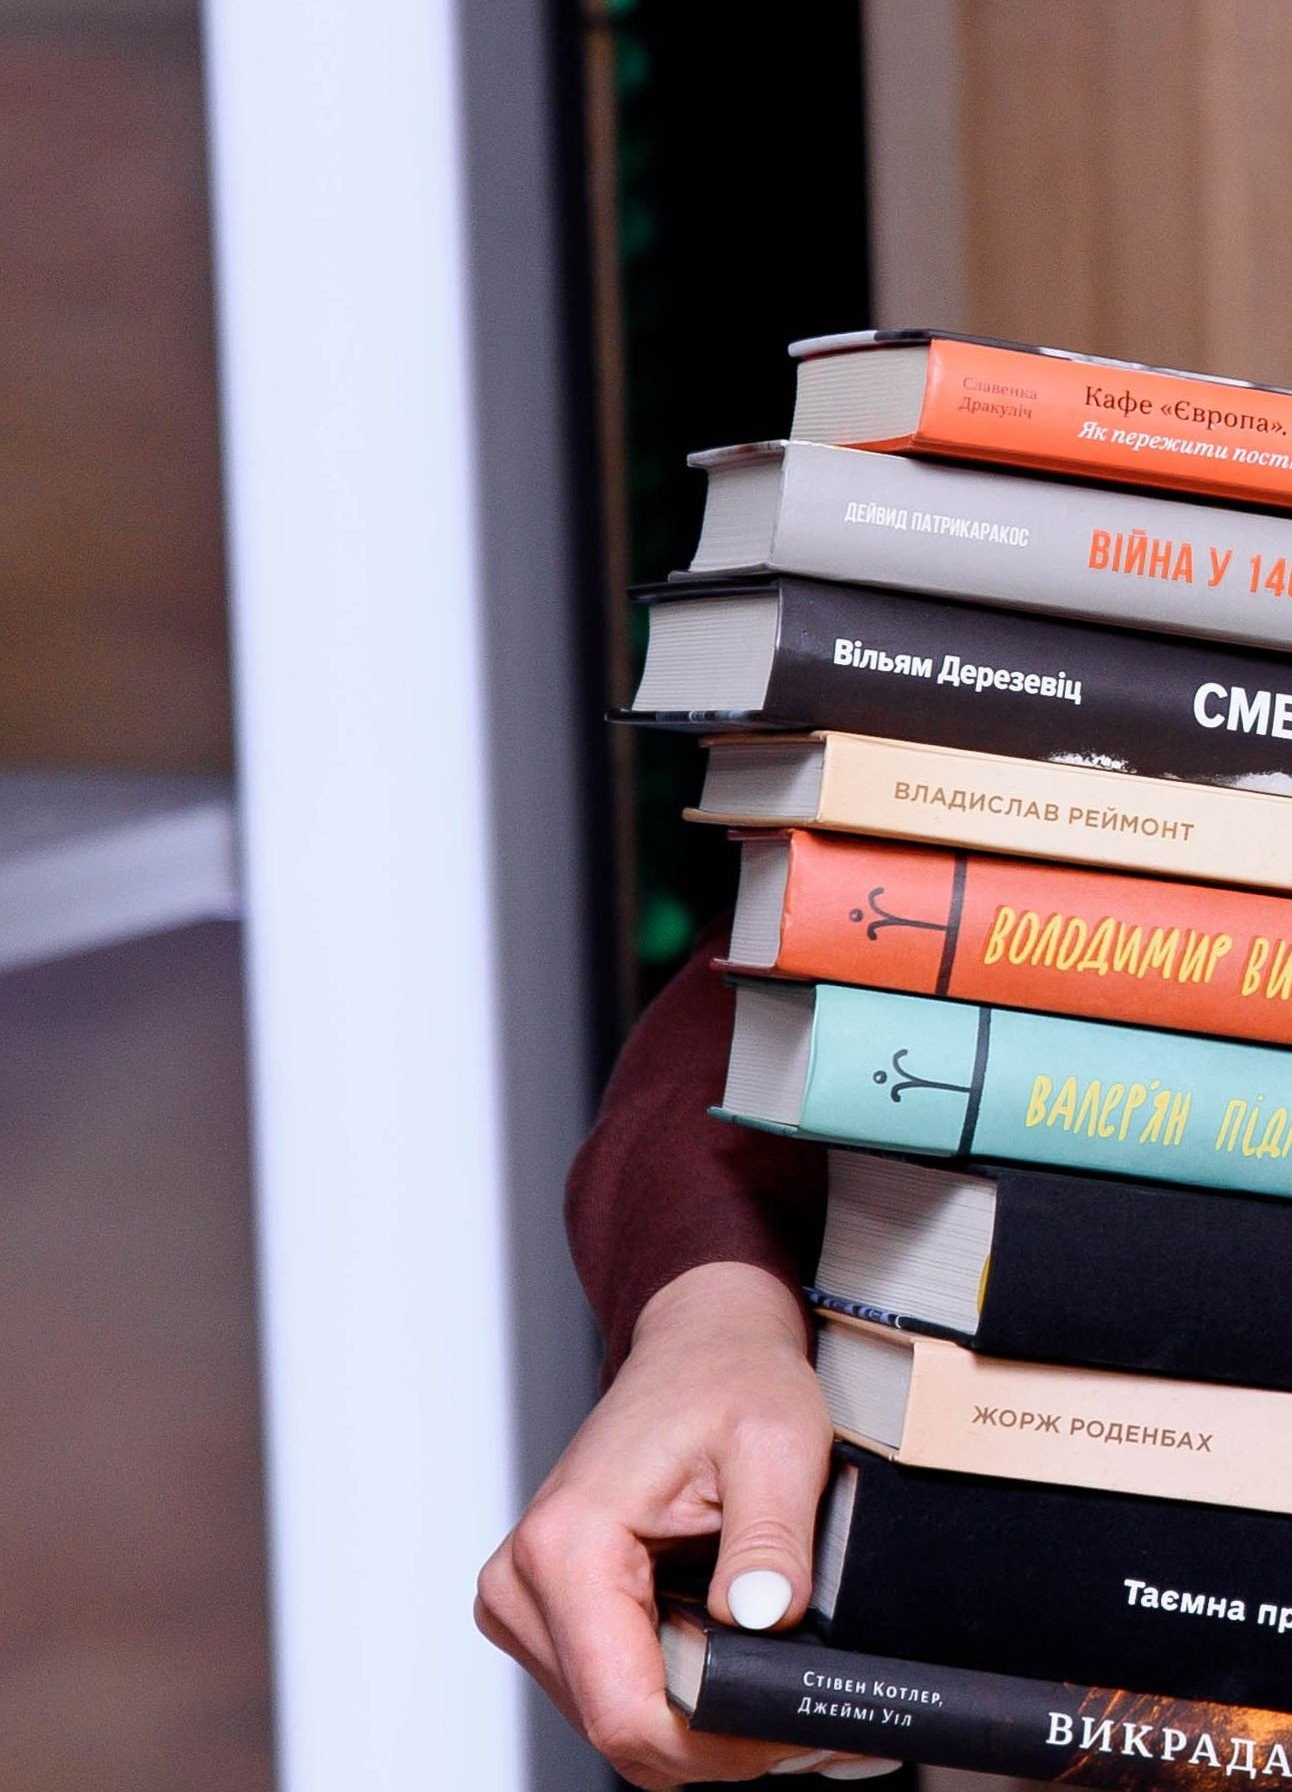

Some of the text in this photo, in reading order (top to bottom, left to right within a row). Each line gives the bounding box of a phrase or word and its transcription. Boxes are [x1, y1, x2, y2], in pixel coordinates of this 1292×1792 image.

[958, 396, 1034, 419] Дракуліч
[962, 376, 1038, 400] Славенка
[1085, 385, 1153, 417] Кафе
[1160, 400, 1286, 437] «Європа».
[1077, 421, 1107, 442] Як
[1111, 430, 1229, 460] пережити
[844, 502, 1029, 547] ДЕЙВИД ПАТРИКАРАКОС
[1087, 527, 1194, 583] ВІЙНА
[1207, 546, 1233, 587] У
[833, 638, 1082, 705] Вільям Дерезевіц
[894, 781, 1195, 841] ВЛАДИСЛАВ РЕЙМОНТ
[983, 905, 1232, 984] ВОЛОДИМИР
[971, 1405, 1213, 1452] ЖОРЖ РОДЕНБАХ
[1124, 1578, 1246, 1621] Таємна
